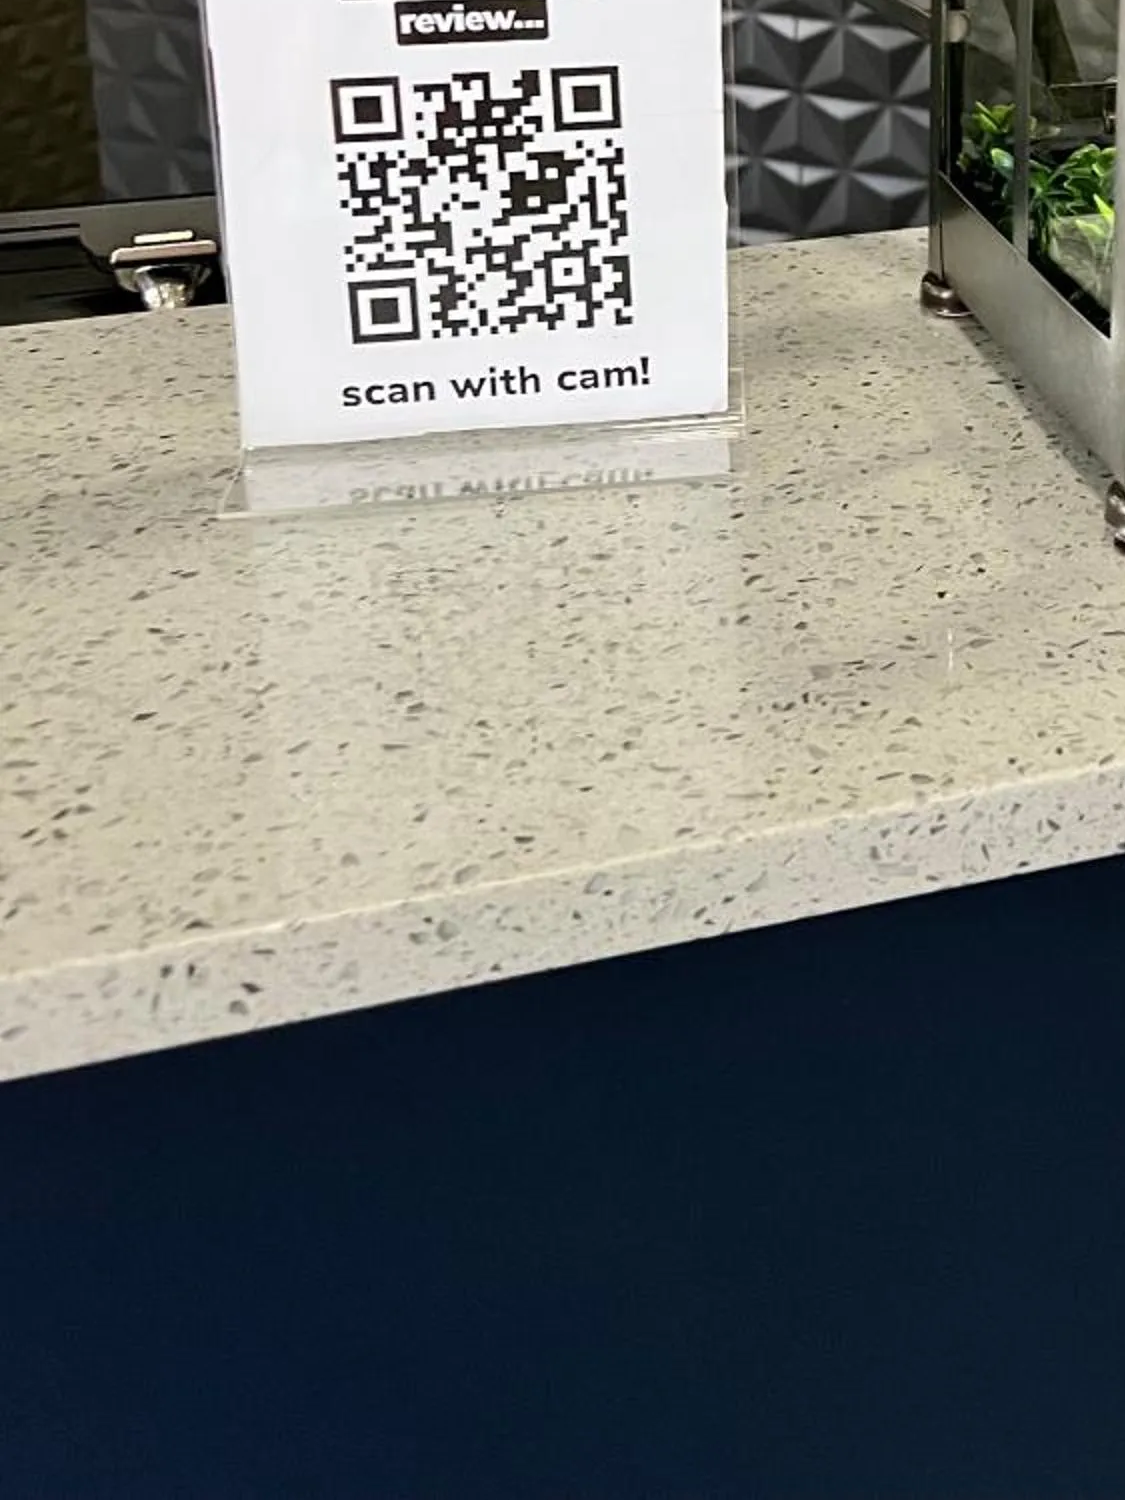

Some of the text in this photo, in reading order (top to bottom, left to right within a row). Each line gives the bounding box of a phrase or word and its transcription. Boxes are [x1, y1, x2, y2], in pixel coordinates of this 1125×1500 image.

[399, 4, 545, 34] review...
[342, 357, 650, 407] scan with cam!
